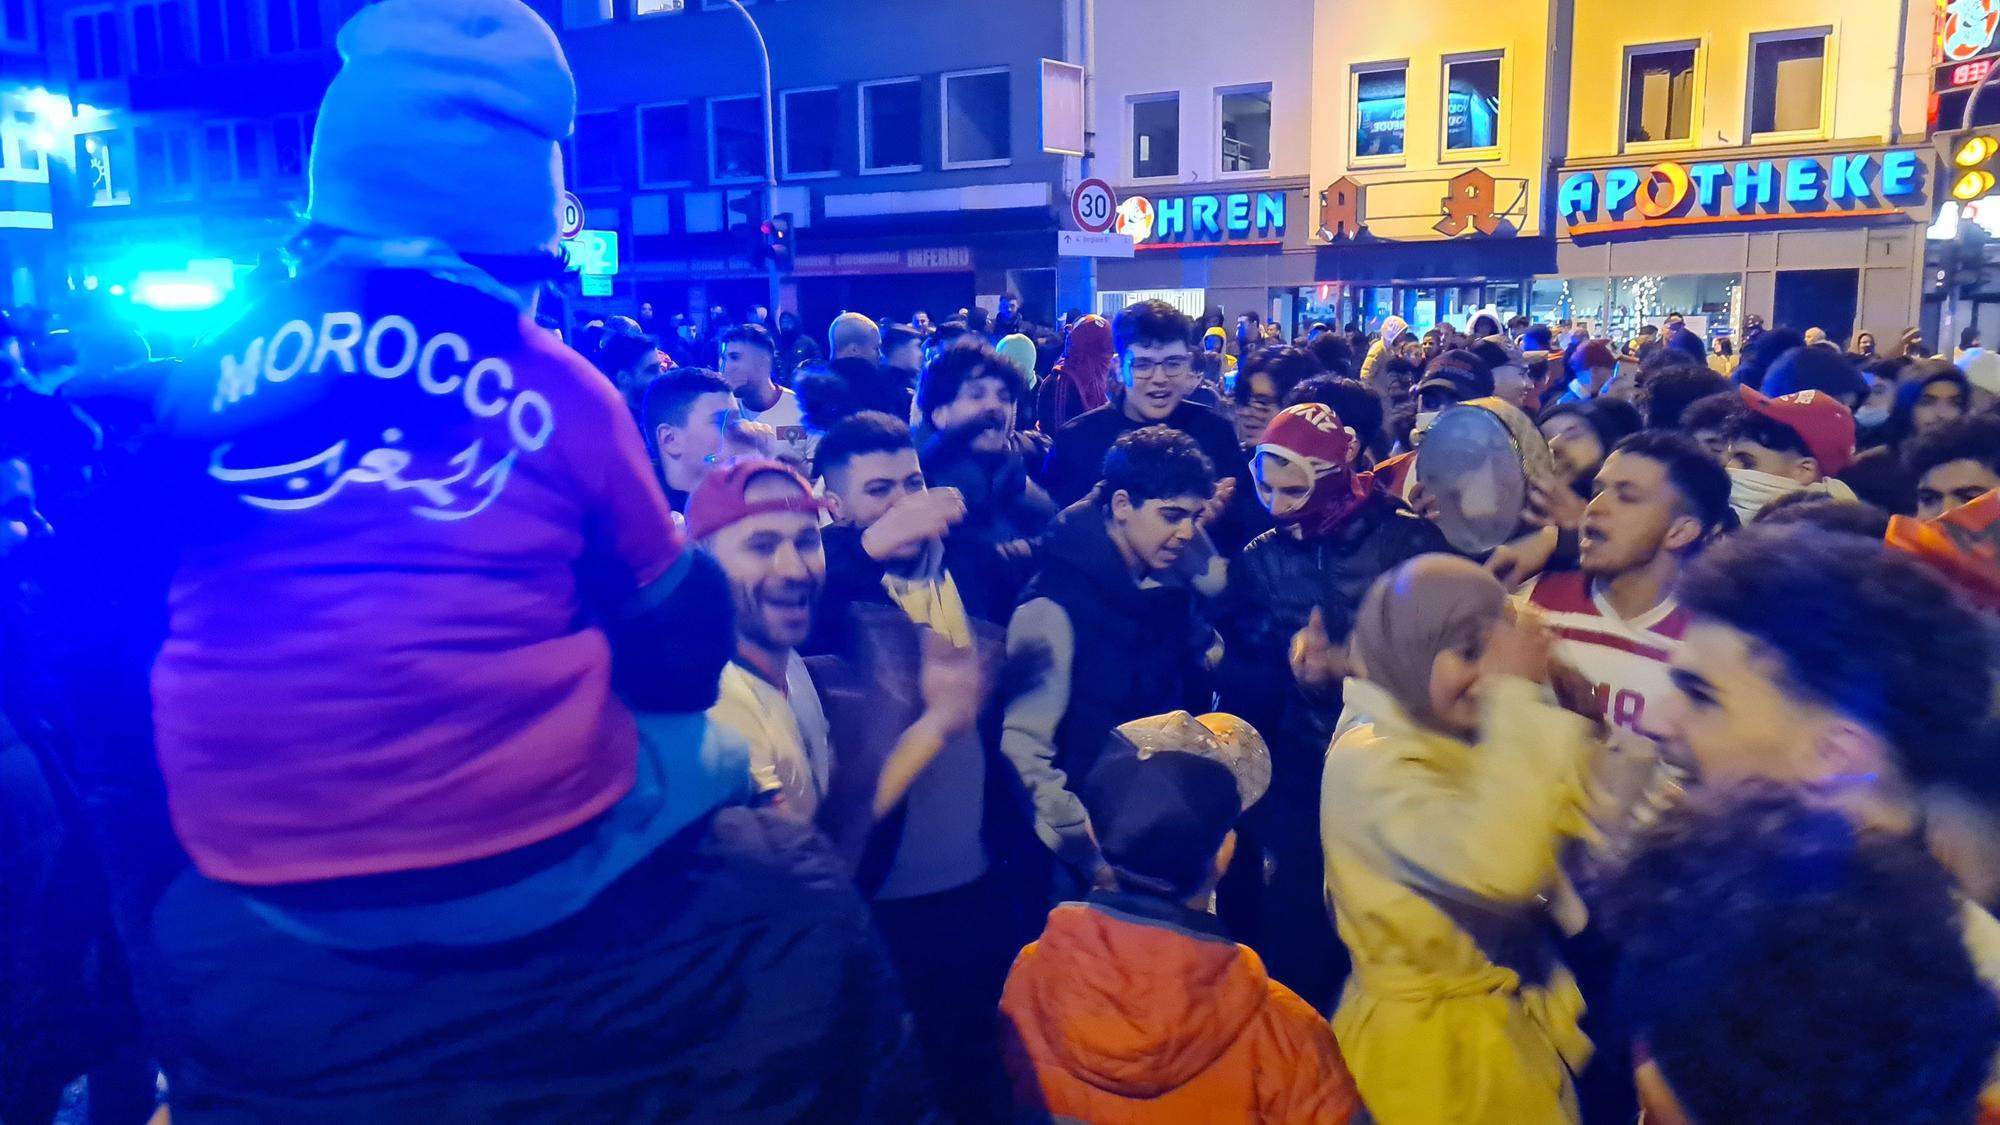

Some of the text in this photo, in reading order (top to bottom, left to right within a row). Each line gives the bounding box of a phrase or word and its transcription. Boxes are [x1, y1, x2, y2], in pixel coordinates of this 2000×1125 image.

[1081, 193, 1107, 218] 30
[1558, 150, 1917, 218] APOTHEKE
[1157, 192, 1286, 238] HREN
[907, 247, 970, 269] INFERNO
[211, 311, 554, 452] MOROCCO
